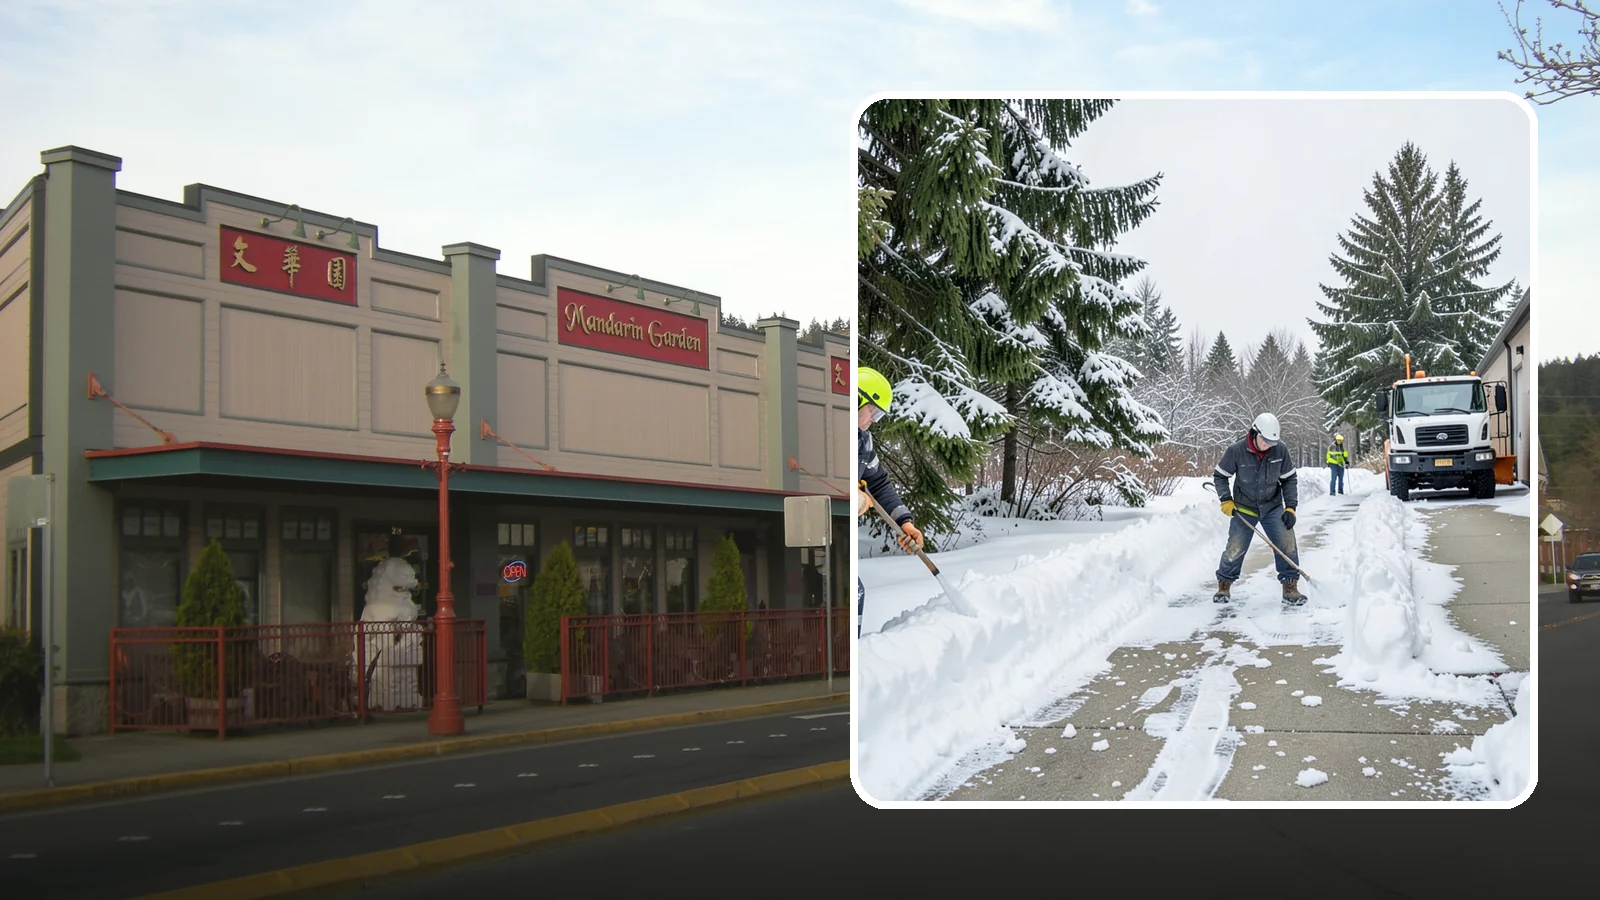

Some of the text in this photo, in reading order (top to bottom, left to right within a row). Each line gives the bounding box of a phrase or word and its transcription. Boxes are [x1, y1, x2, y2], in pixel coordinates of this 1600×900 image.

[564, 302, 701, 352] Mandarin Garden
[503, 565, 527, 578] OPEN
